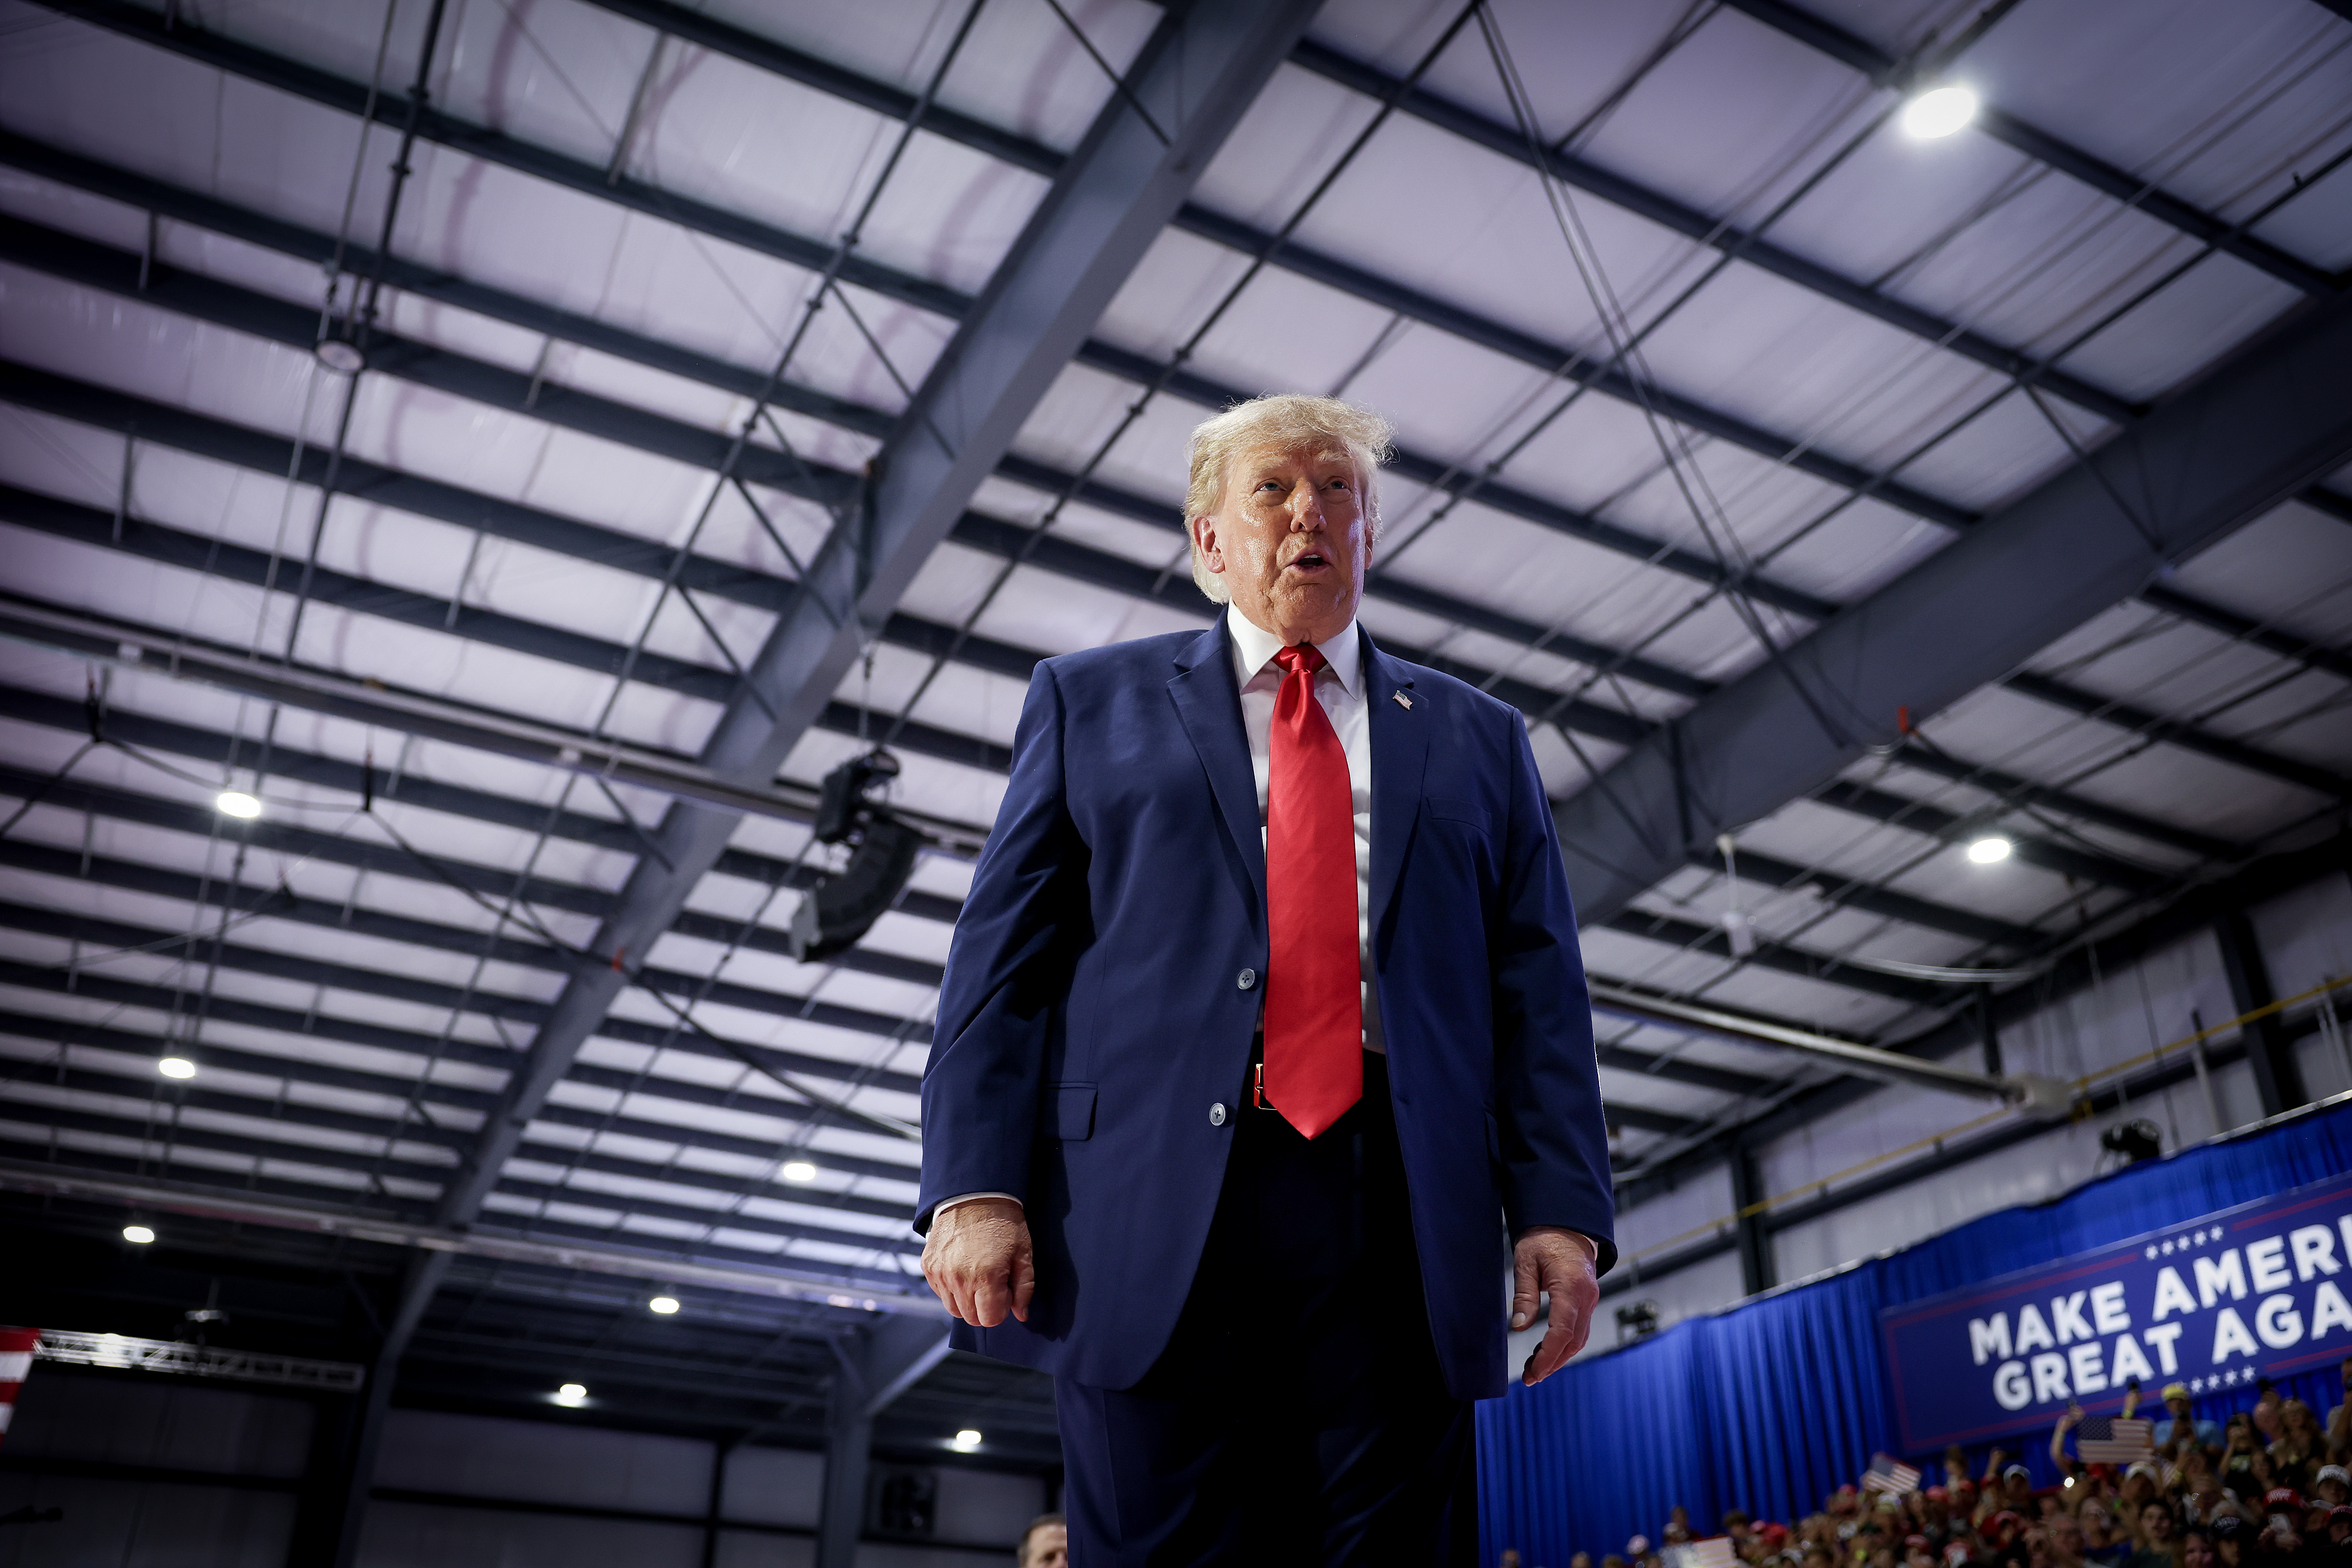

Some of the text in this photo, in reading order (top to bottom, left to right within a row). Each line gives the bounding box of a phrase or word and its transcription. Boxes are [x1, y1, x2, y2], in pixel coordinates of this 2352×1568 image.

[1969, 1280, 2132, 1365] MAKE
[1993, 1280, 2352, 1411] GREAT AGA
